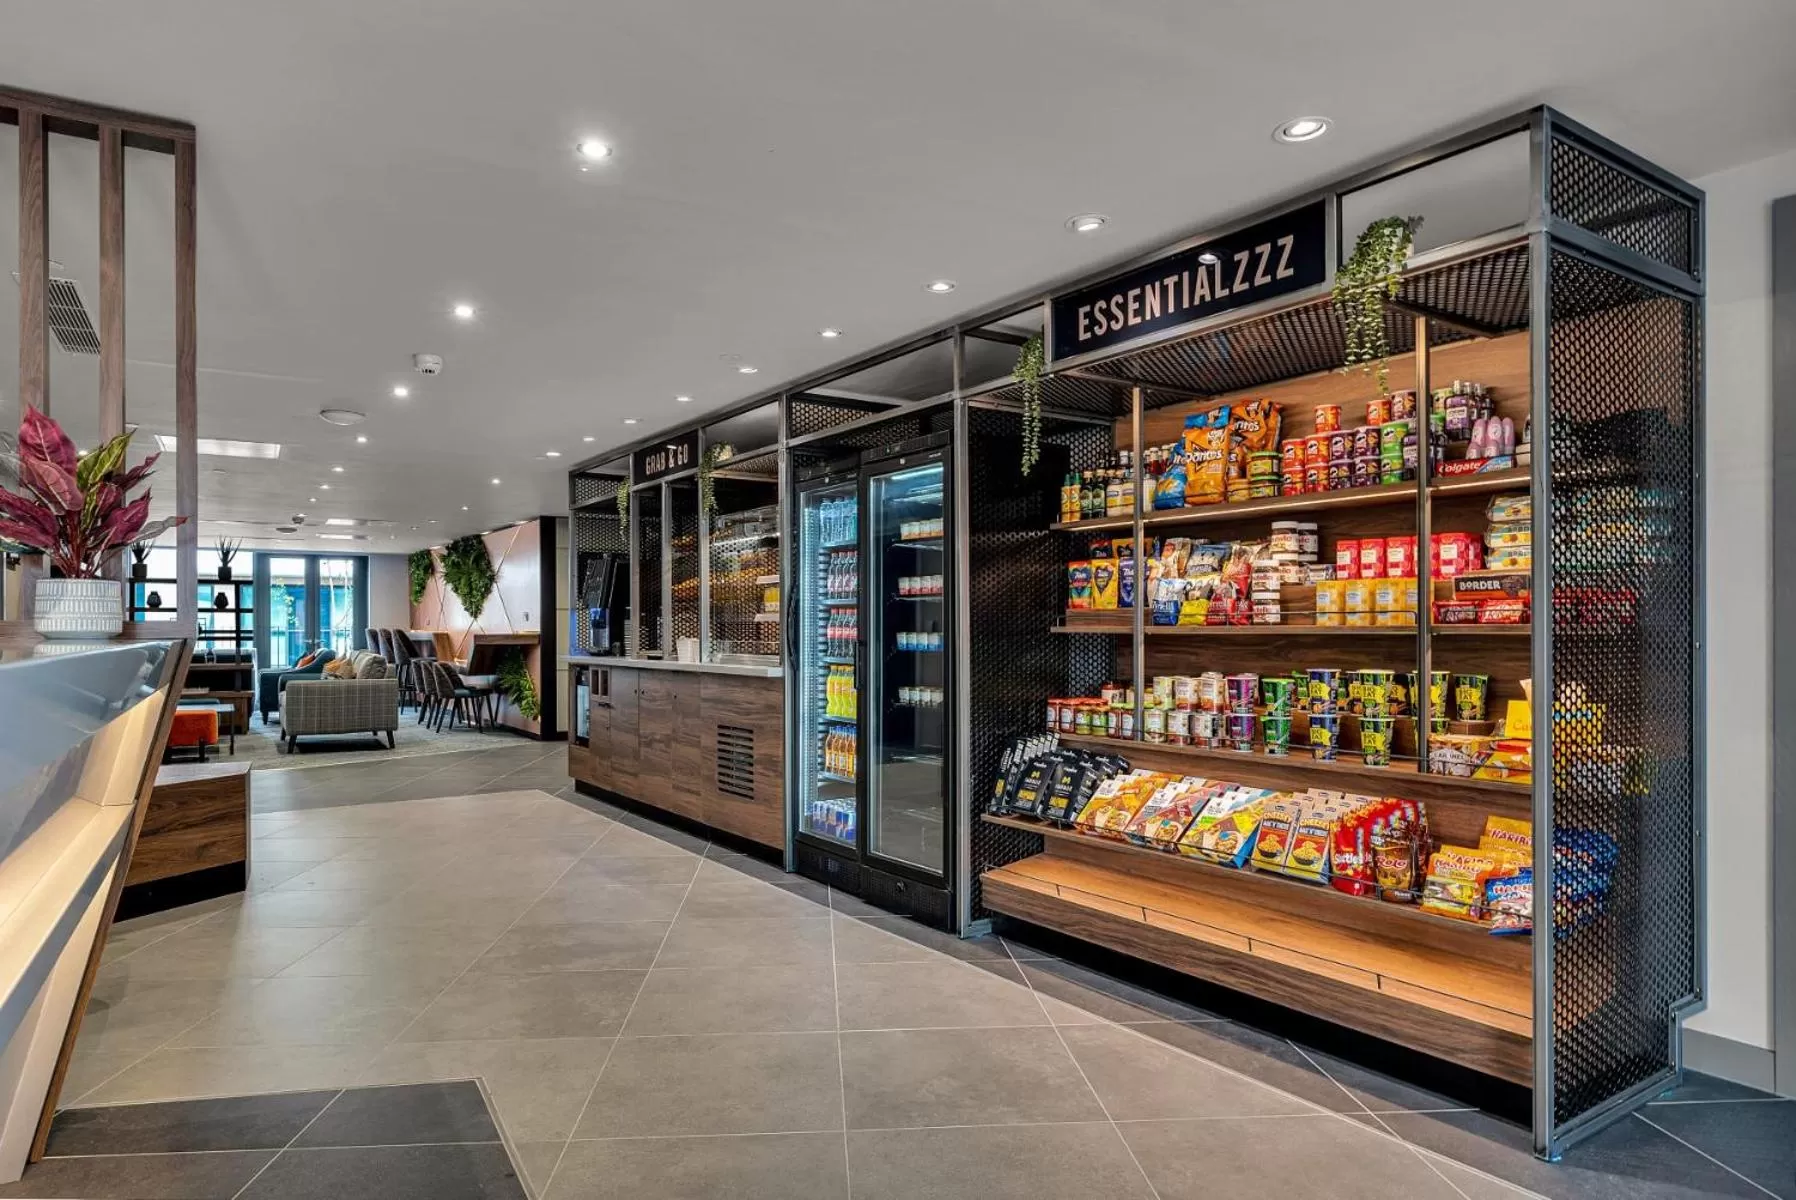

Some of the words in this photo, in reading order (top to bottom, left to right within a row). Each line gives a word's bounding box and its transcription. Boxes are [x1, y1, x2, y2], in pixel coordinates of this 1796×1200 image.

[1077, 234, 1295, 342] ESSENTIALZZZ
[645, 451, 666, 476] GRAB
[668, 448, 675, 469] &
[677, 443, 689, 466] GO
[1184, 449, 1223, 464] Doritos
[1438, 462, 1482, 474] Colgate
[1459, 580, 1501, 591] BORDER
